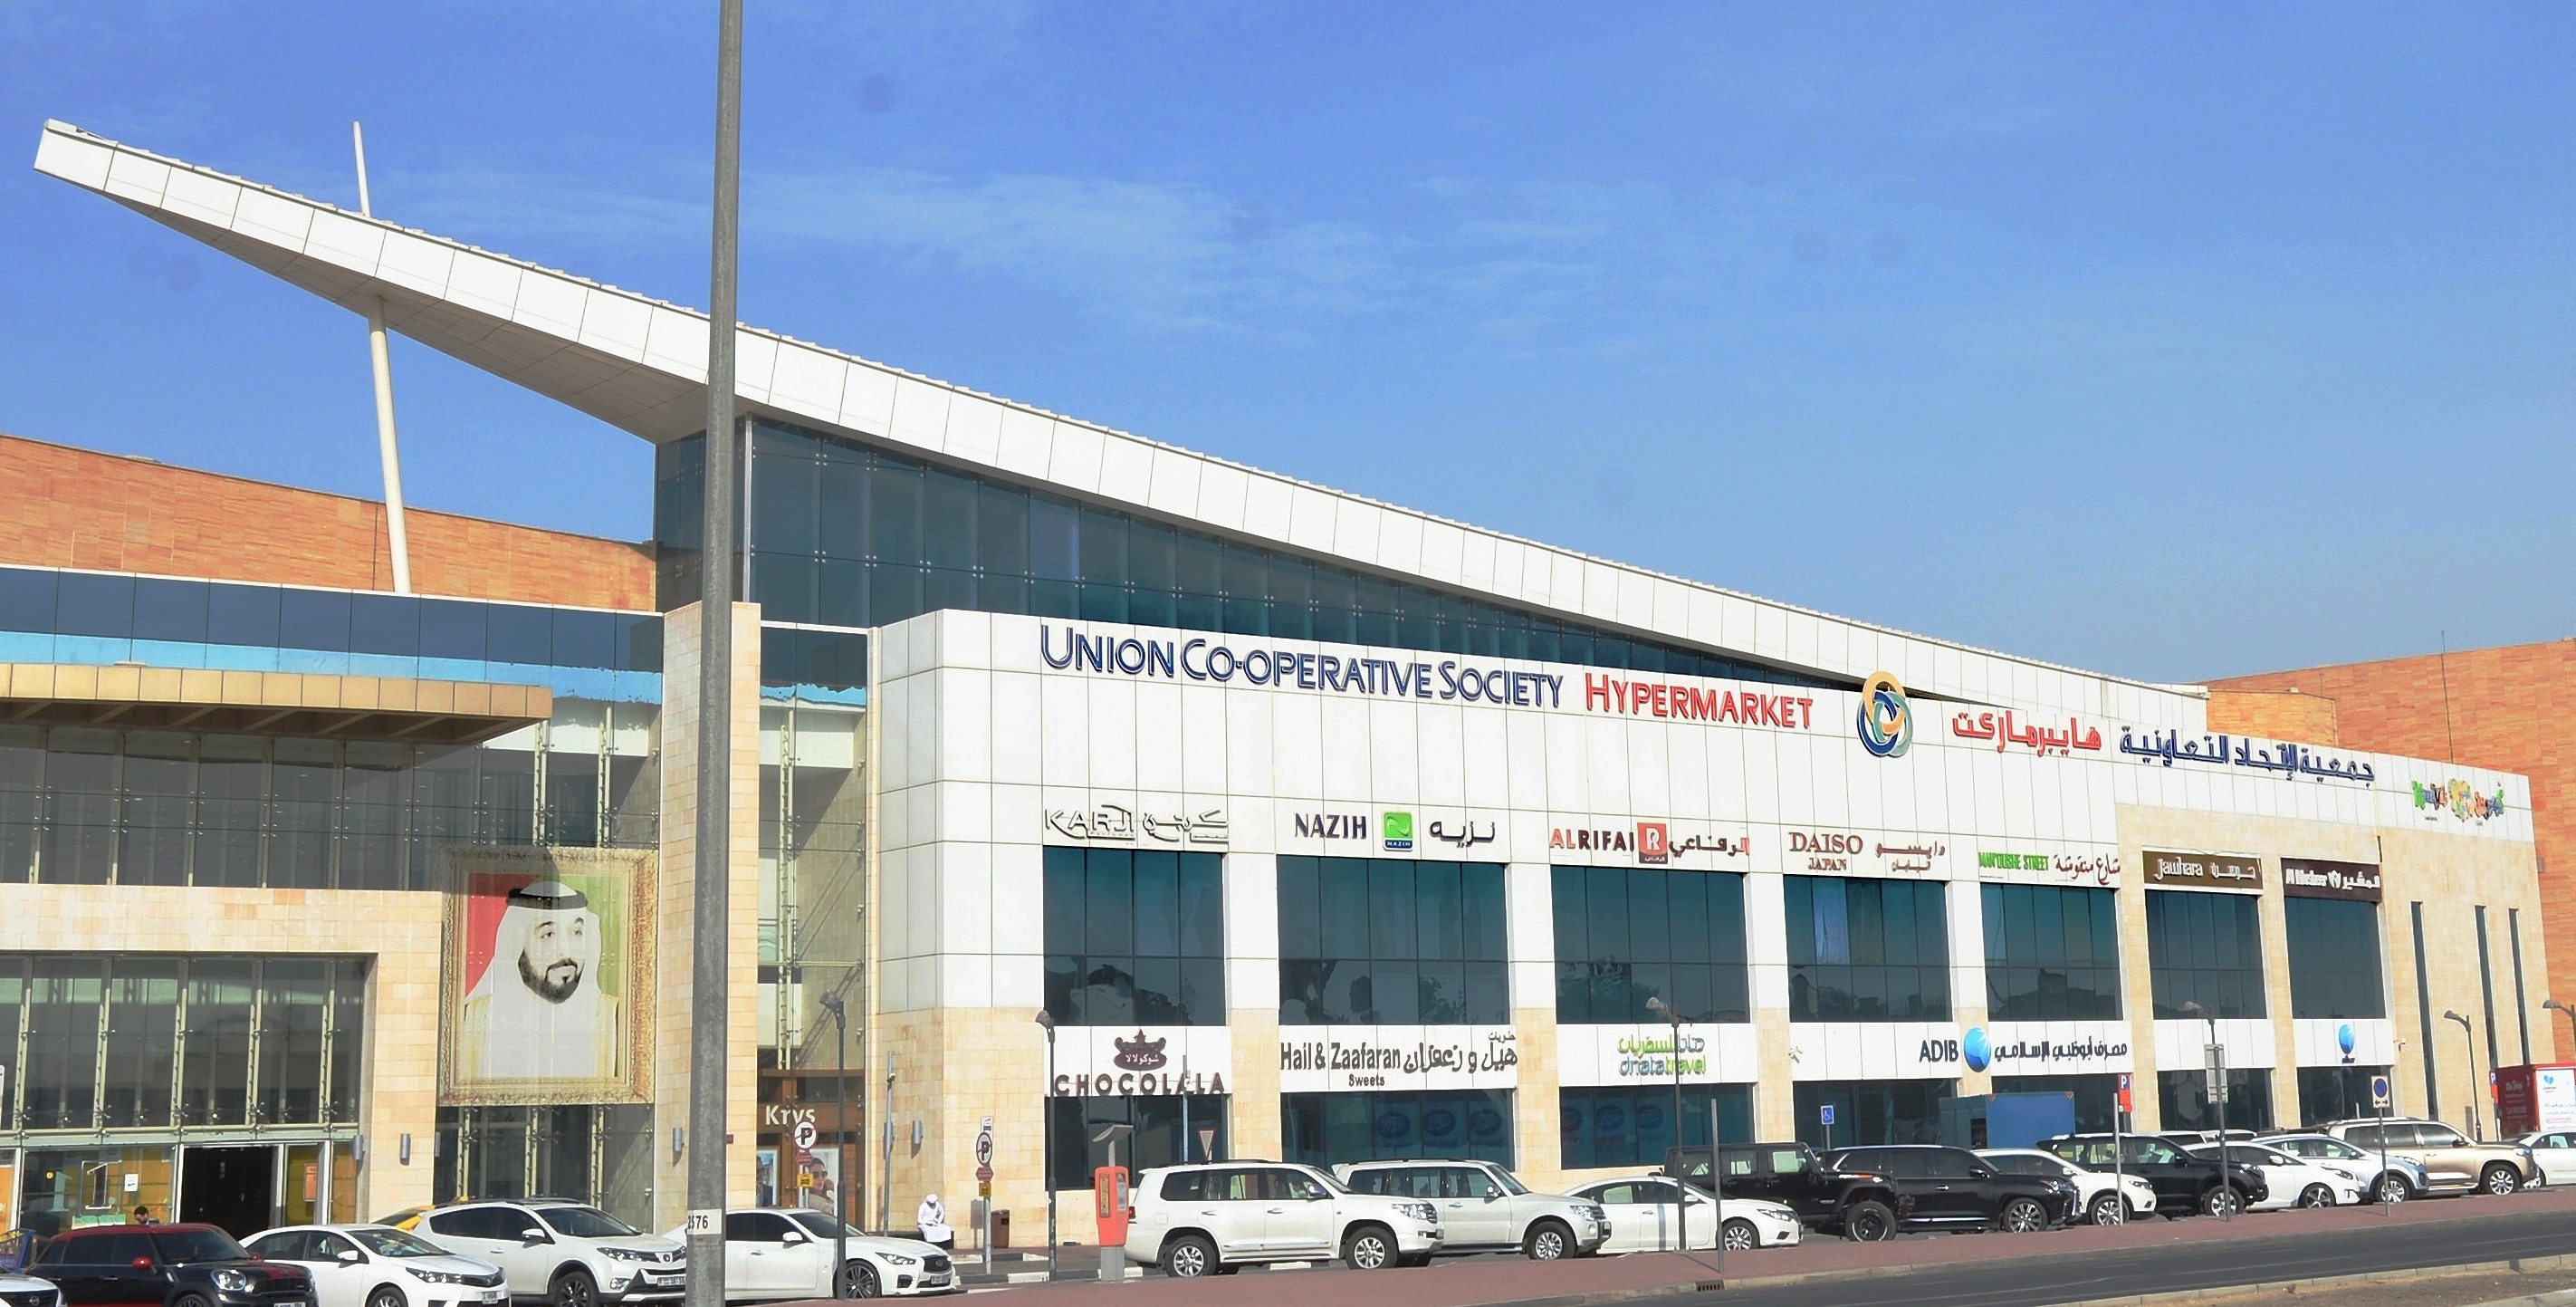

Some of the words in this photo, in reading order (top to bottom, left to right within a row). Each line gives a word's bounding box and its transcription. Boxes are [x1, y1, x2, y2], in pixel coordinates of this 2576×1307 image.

[1041, 624, 1174, 678] UNION
[1181, 638, 1433, 699] CO-OPERATIVE
[1438, 660, 1564, 708] SOCIETY
[1585, 672, 1814, 730] HYPERMARKET
[1952, 710, 2102, 757] هايبرماركت
[2120, 726, 2230, 768] التعاونية
[2300, 747, 2375, 790] جمعية
[1295, 812, 1367, 840] NAZIH
[1430, 821, 1496, 848] نزيه
[1669, 834, 1750, 859] الرفاعي
[1788, 831, 1864, 855] DAISO
[1807, 857, 1847, 871] JAPAN
[2023, 855, 2049, 871] STREET
[1280, 1043, 1312, 1071] Hail
[1315, 1042, 1326, 1070] &
[1331, 1042, 1402, 1071] Zaafaran
[1403, 1042, 1463, 1074] زعفران
[1468, 1050, 1478, 1074] و
[1480, 1042, 1518, 1072] هيل
[1919, 1039, 1959, 1062] ADIB
[2094, 1041, 2128, 1061] مصرف
[1348, 1073, 1385, 1087] Sweets
[765, 1105, 816, 1125] Krys
